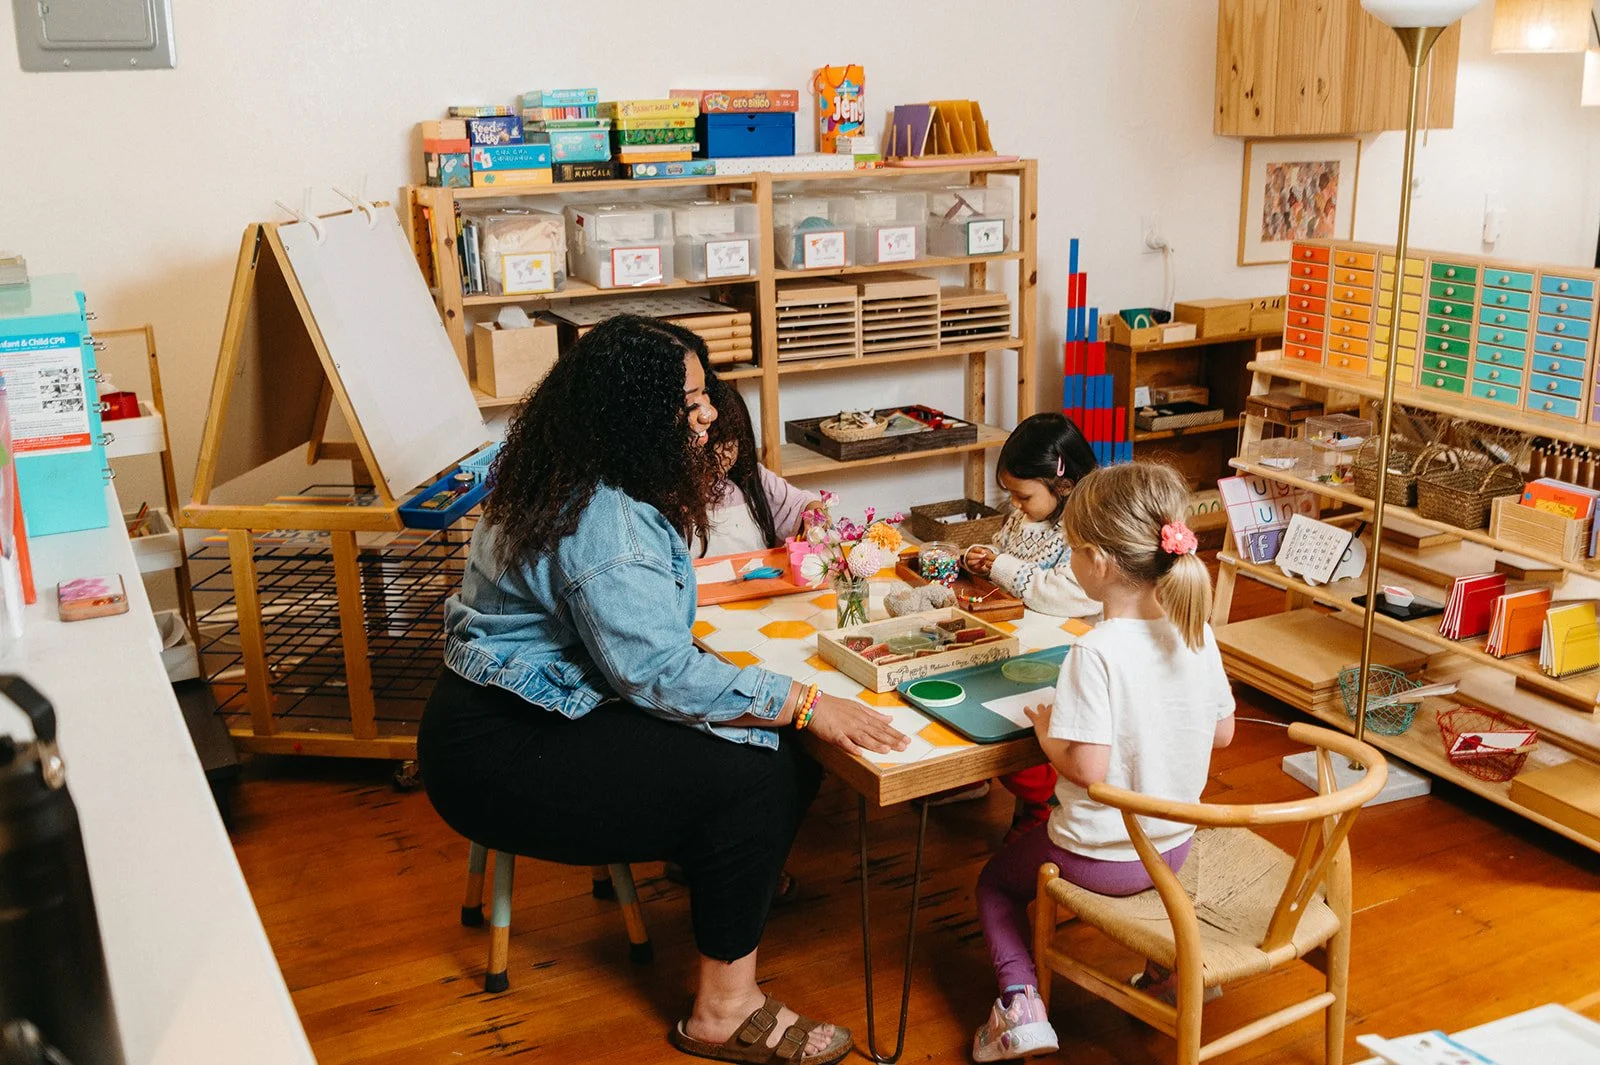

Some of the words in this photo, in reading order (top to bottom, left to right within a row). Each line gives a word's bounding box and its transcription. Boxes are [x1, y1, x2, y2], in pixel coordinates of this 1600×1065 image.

[732, 98, 748, 109] GEO
[748, 98, 770, 109] BINGO
[471, 121, 497, 133] Feed
[475, 132, 500, 146] Kitty
[574, 169, 611, 178] MANCALA
[28, 337, 49, 346] Child
[49, 336, 66, 345] CPR
